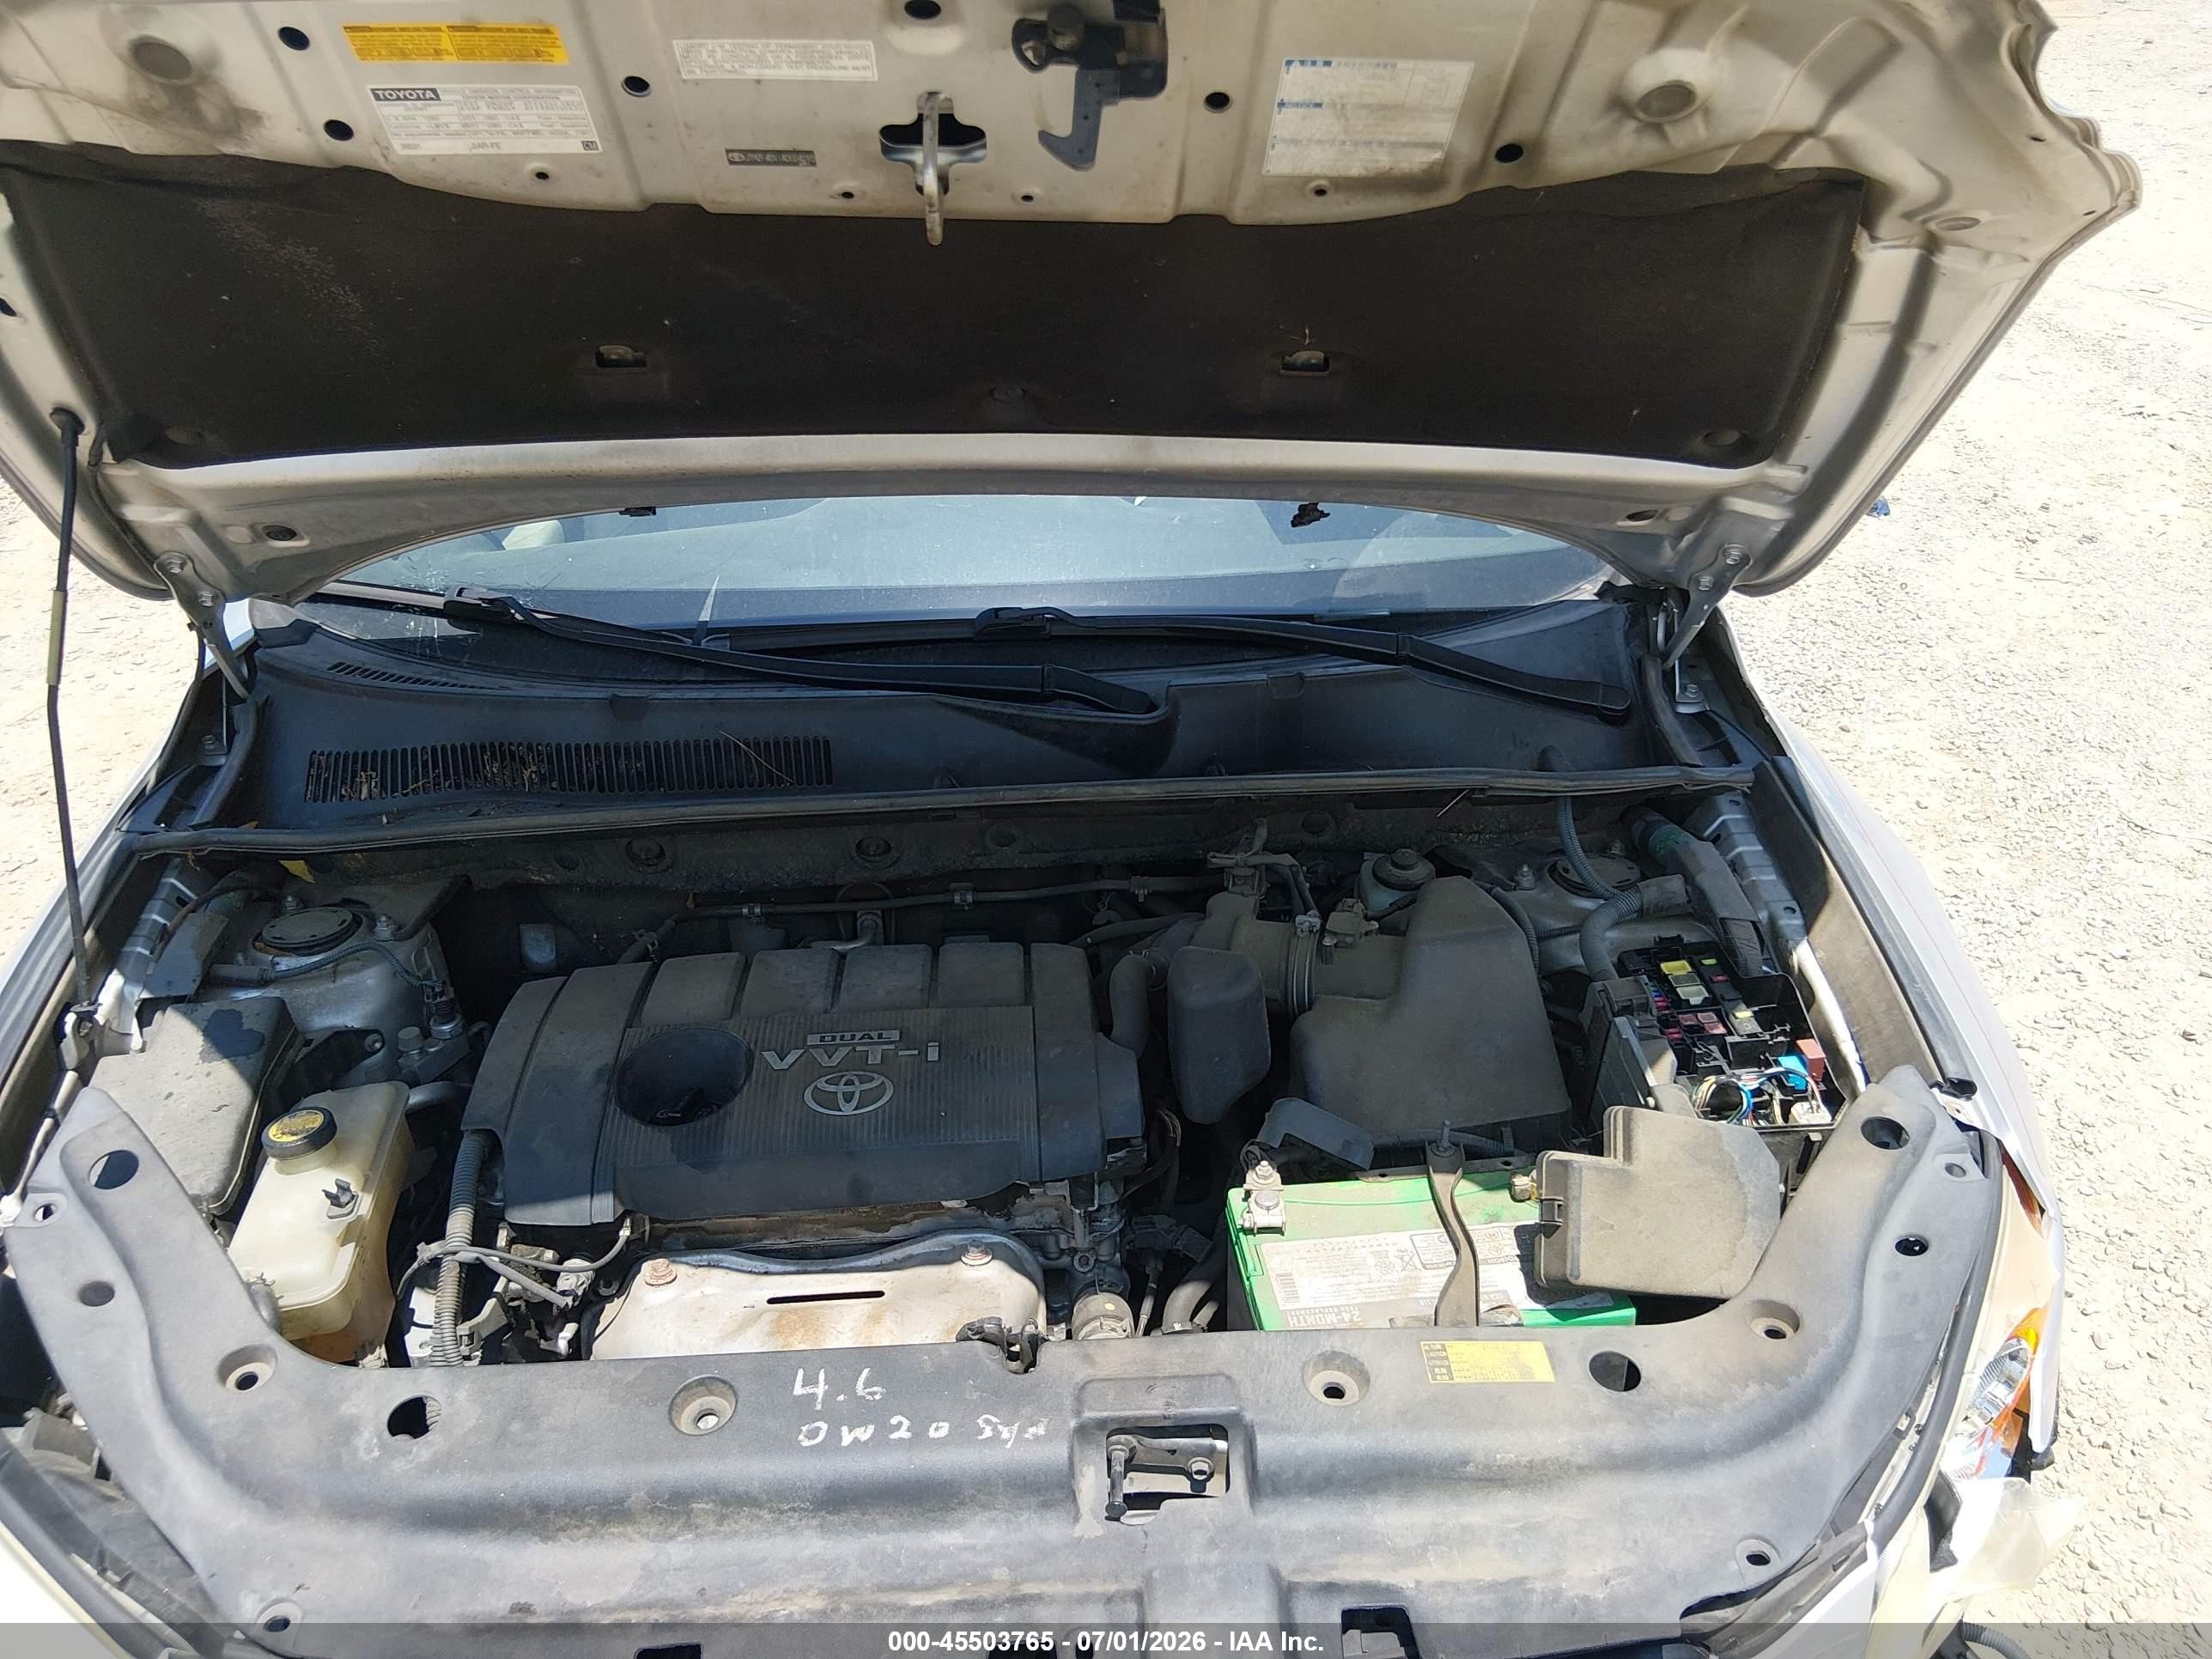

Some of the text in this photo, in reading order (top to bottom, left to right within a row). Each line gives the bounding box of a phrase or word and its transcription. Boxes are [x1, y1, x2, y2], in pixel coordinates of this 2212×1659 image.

[374, 89, 438, 100] TOYOTA
[818, 1032, 892, 1043] DUAL
[761, 1042, 940, 1070] VVT-i
[1287, 1310, 1361, 1328] 24-MONTH
[793, 1368, 886, 1411] 4.6
